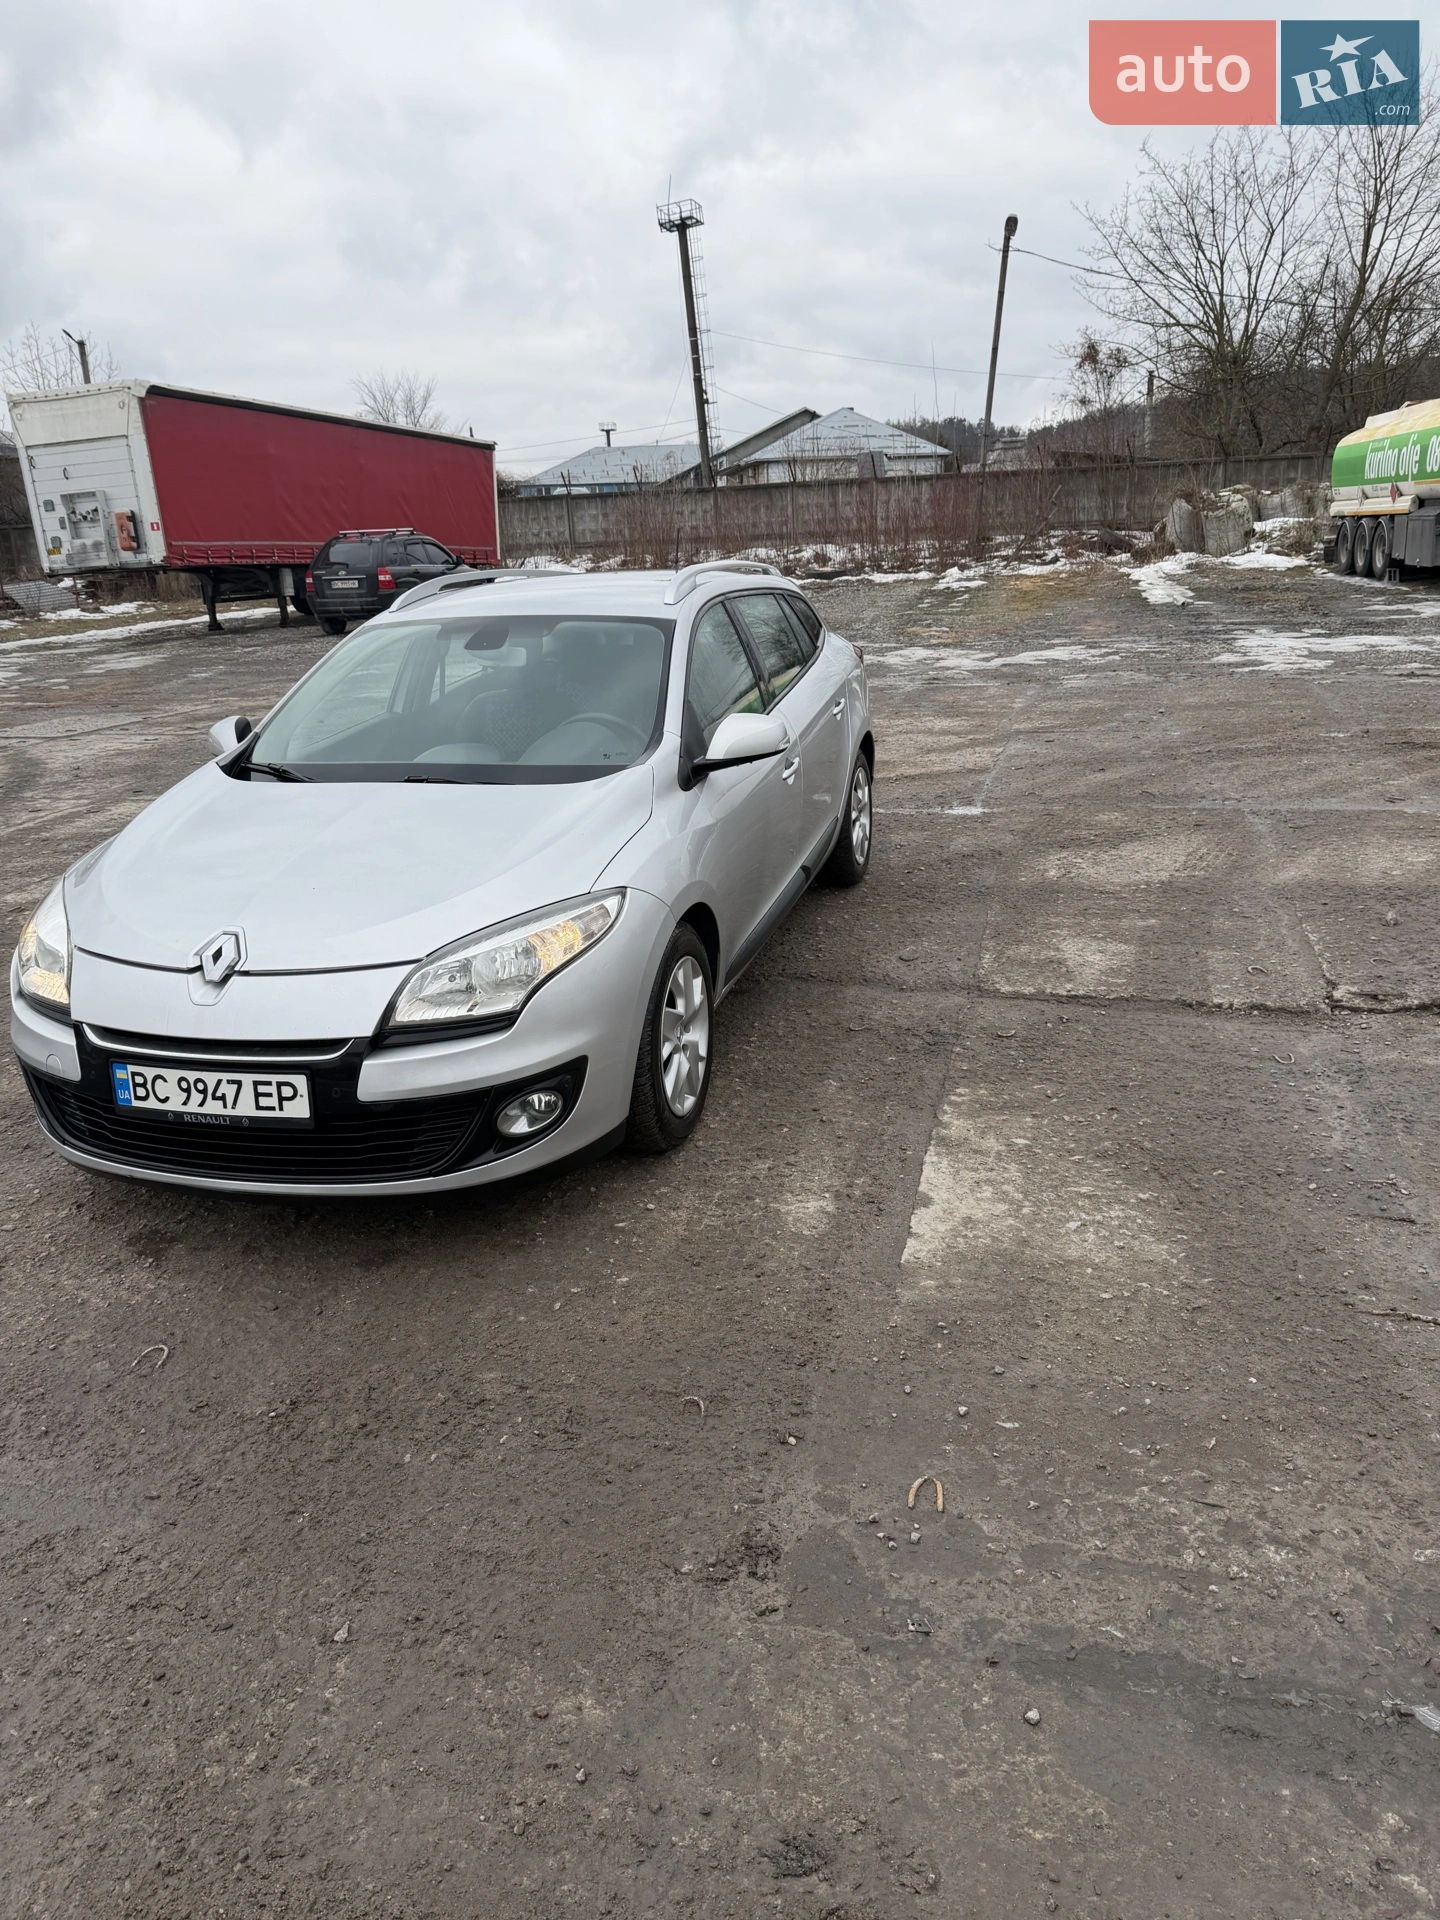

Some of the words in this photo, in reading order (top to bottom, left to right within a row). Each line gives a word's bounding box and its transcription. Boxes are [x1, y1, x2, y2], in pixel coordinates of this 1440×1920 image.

[1399, 433, 1420, 482] olje
[118, 1089, 131, 1100] UA
[131, 1071, 170, 1104] BC
[176, 1076, 243, 1110] 9947
[252, 1080, 298, 1111] EP
[183, 1113, 231, 1125] RENAULT
